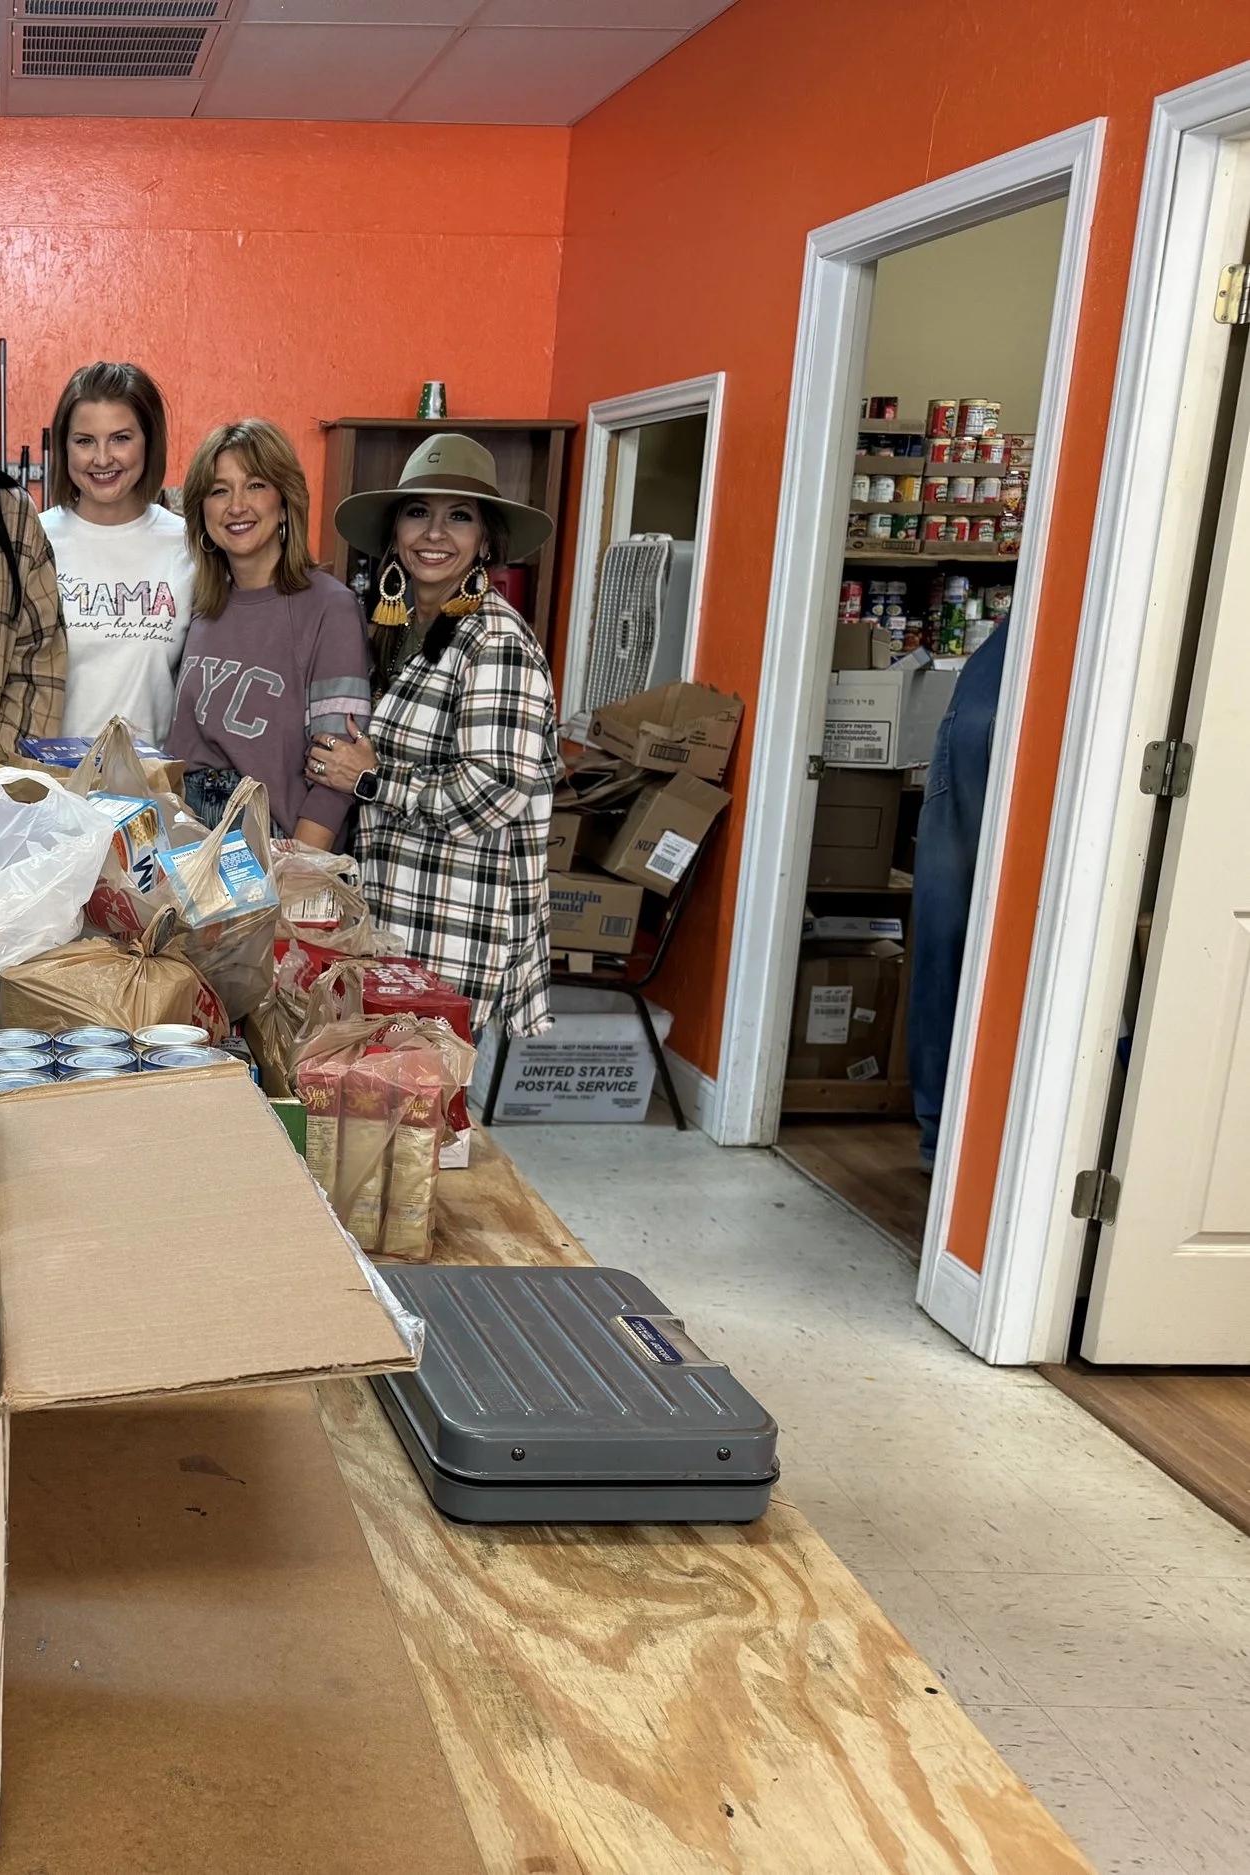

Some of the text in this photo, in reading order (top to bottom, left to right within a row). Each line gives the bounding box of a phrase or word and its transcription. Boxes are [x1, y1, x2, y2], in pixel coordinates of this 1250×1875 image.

[58, 581, 176, 618] MAMA
[113, 617, 137, 630] her
[138, 617, 173, 632] heart
[121, 628, 141, 640] her
[142, 630, 176, 643] sleeve
[522, 1066, 634, 1077] UNITED STATES
[514, 1081, 639, 1093] POSTAL SERVICE
